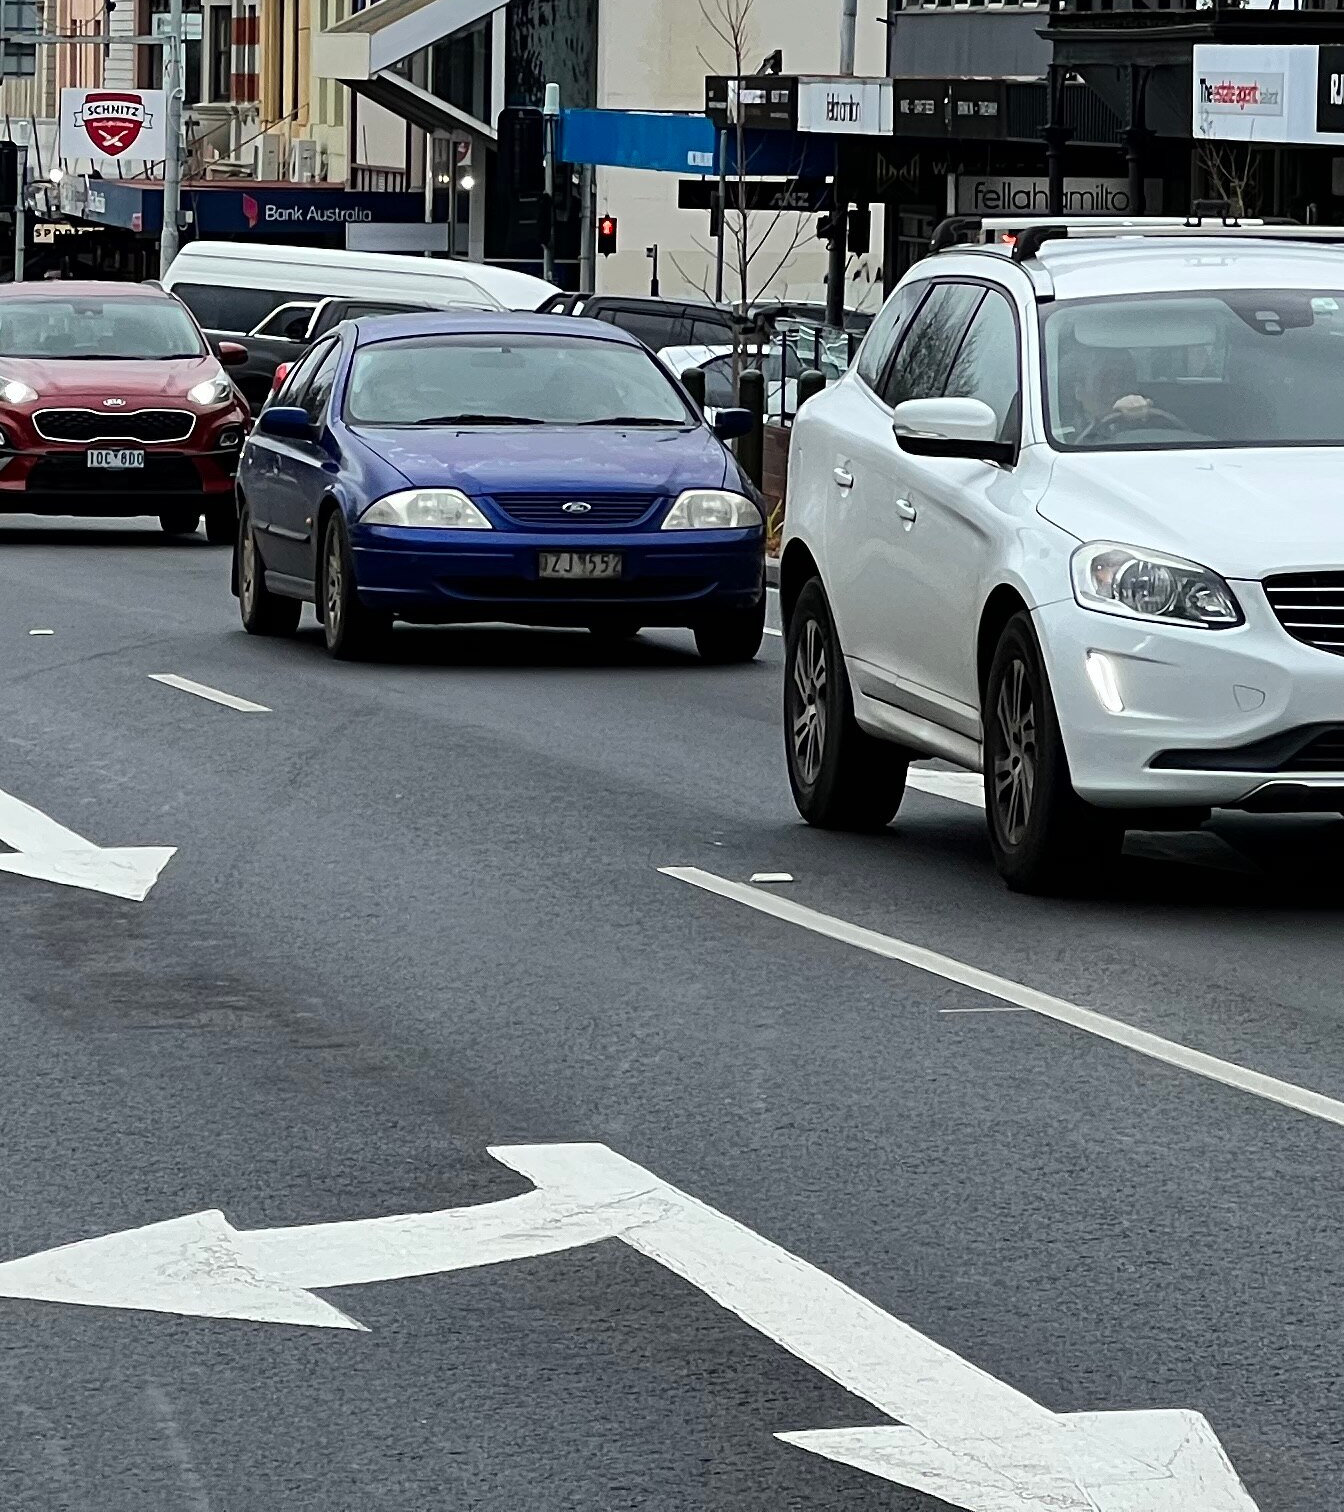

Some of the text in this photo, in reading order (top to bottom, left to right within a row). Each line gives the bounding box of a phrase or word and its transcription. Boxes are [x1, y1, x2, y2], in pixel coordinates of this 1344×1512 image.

[87, 104, 140, 117] SCHNITZ
[265, 204, 372, 221] Bank Australia
